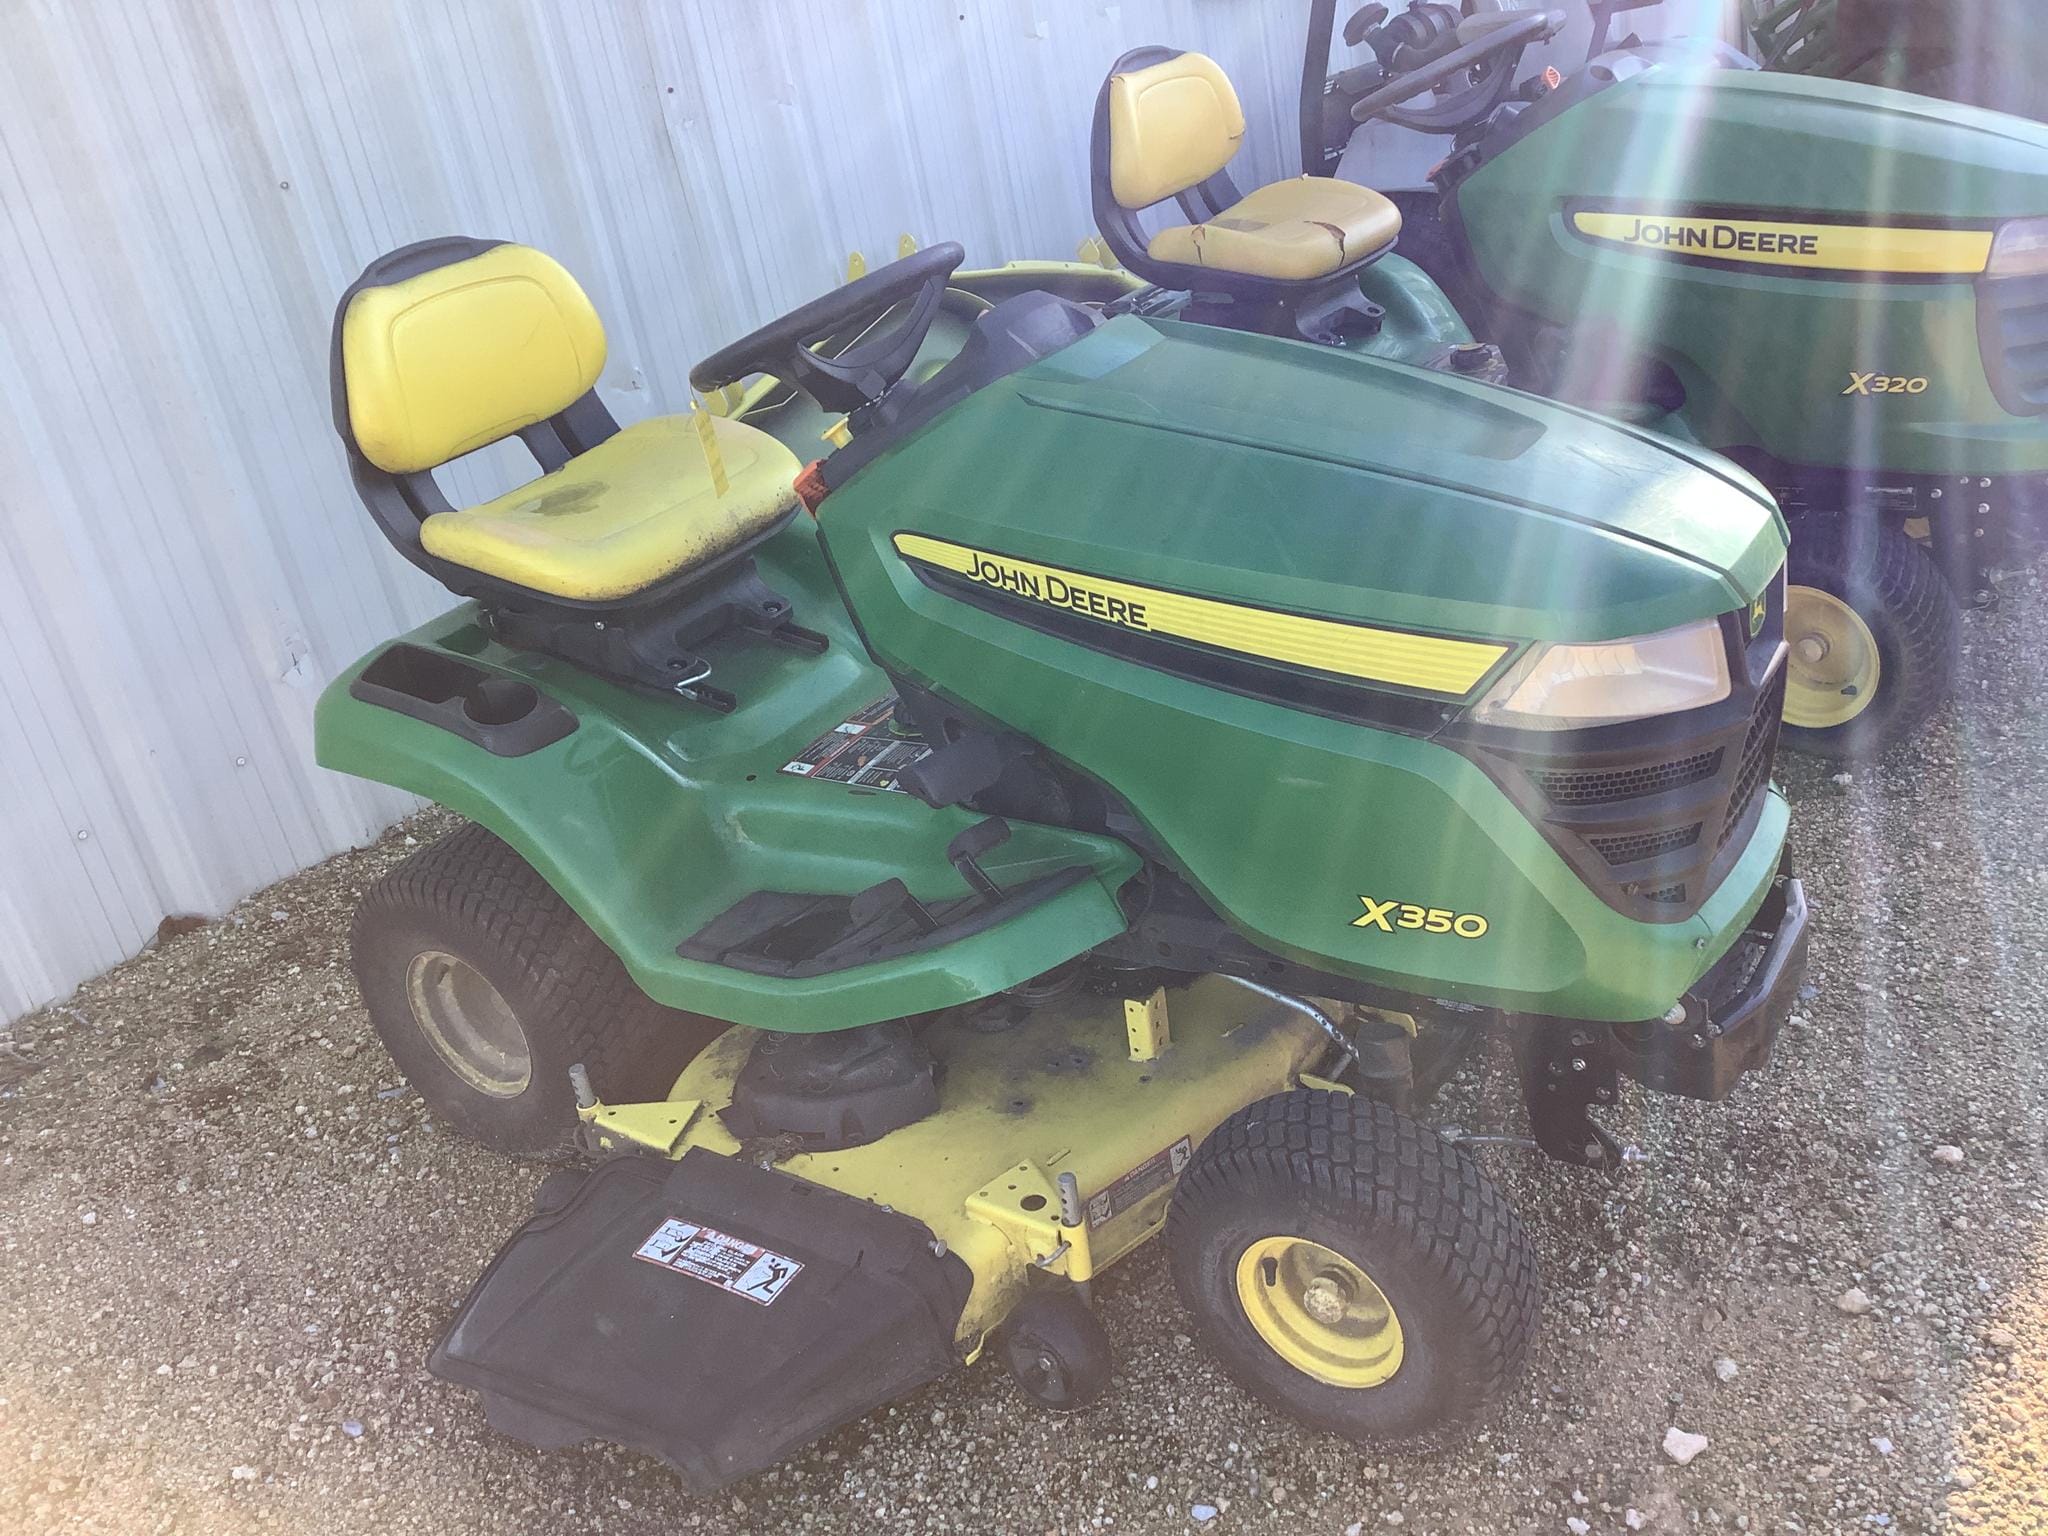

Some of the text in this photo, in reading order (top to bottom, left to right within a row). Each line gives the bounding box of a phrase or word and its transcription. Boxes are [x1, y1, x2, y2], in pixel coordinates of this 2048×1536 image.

[1623, 218, 1818, 255] JOHN DEERE
[1840, 371, 1929, 396] X320
[966, 552, 1148, 628] JOHN DEERE
[1349, 894, 1489, 939] X350
[716, 1232, 758, 1255] DANG
